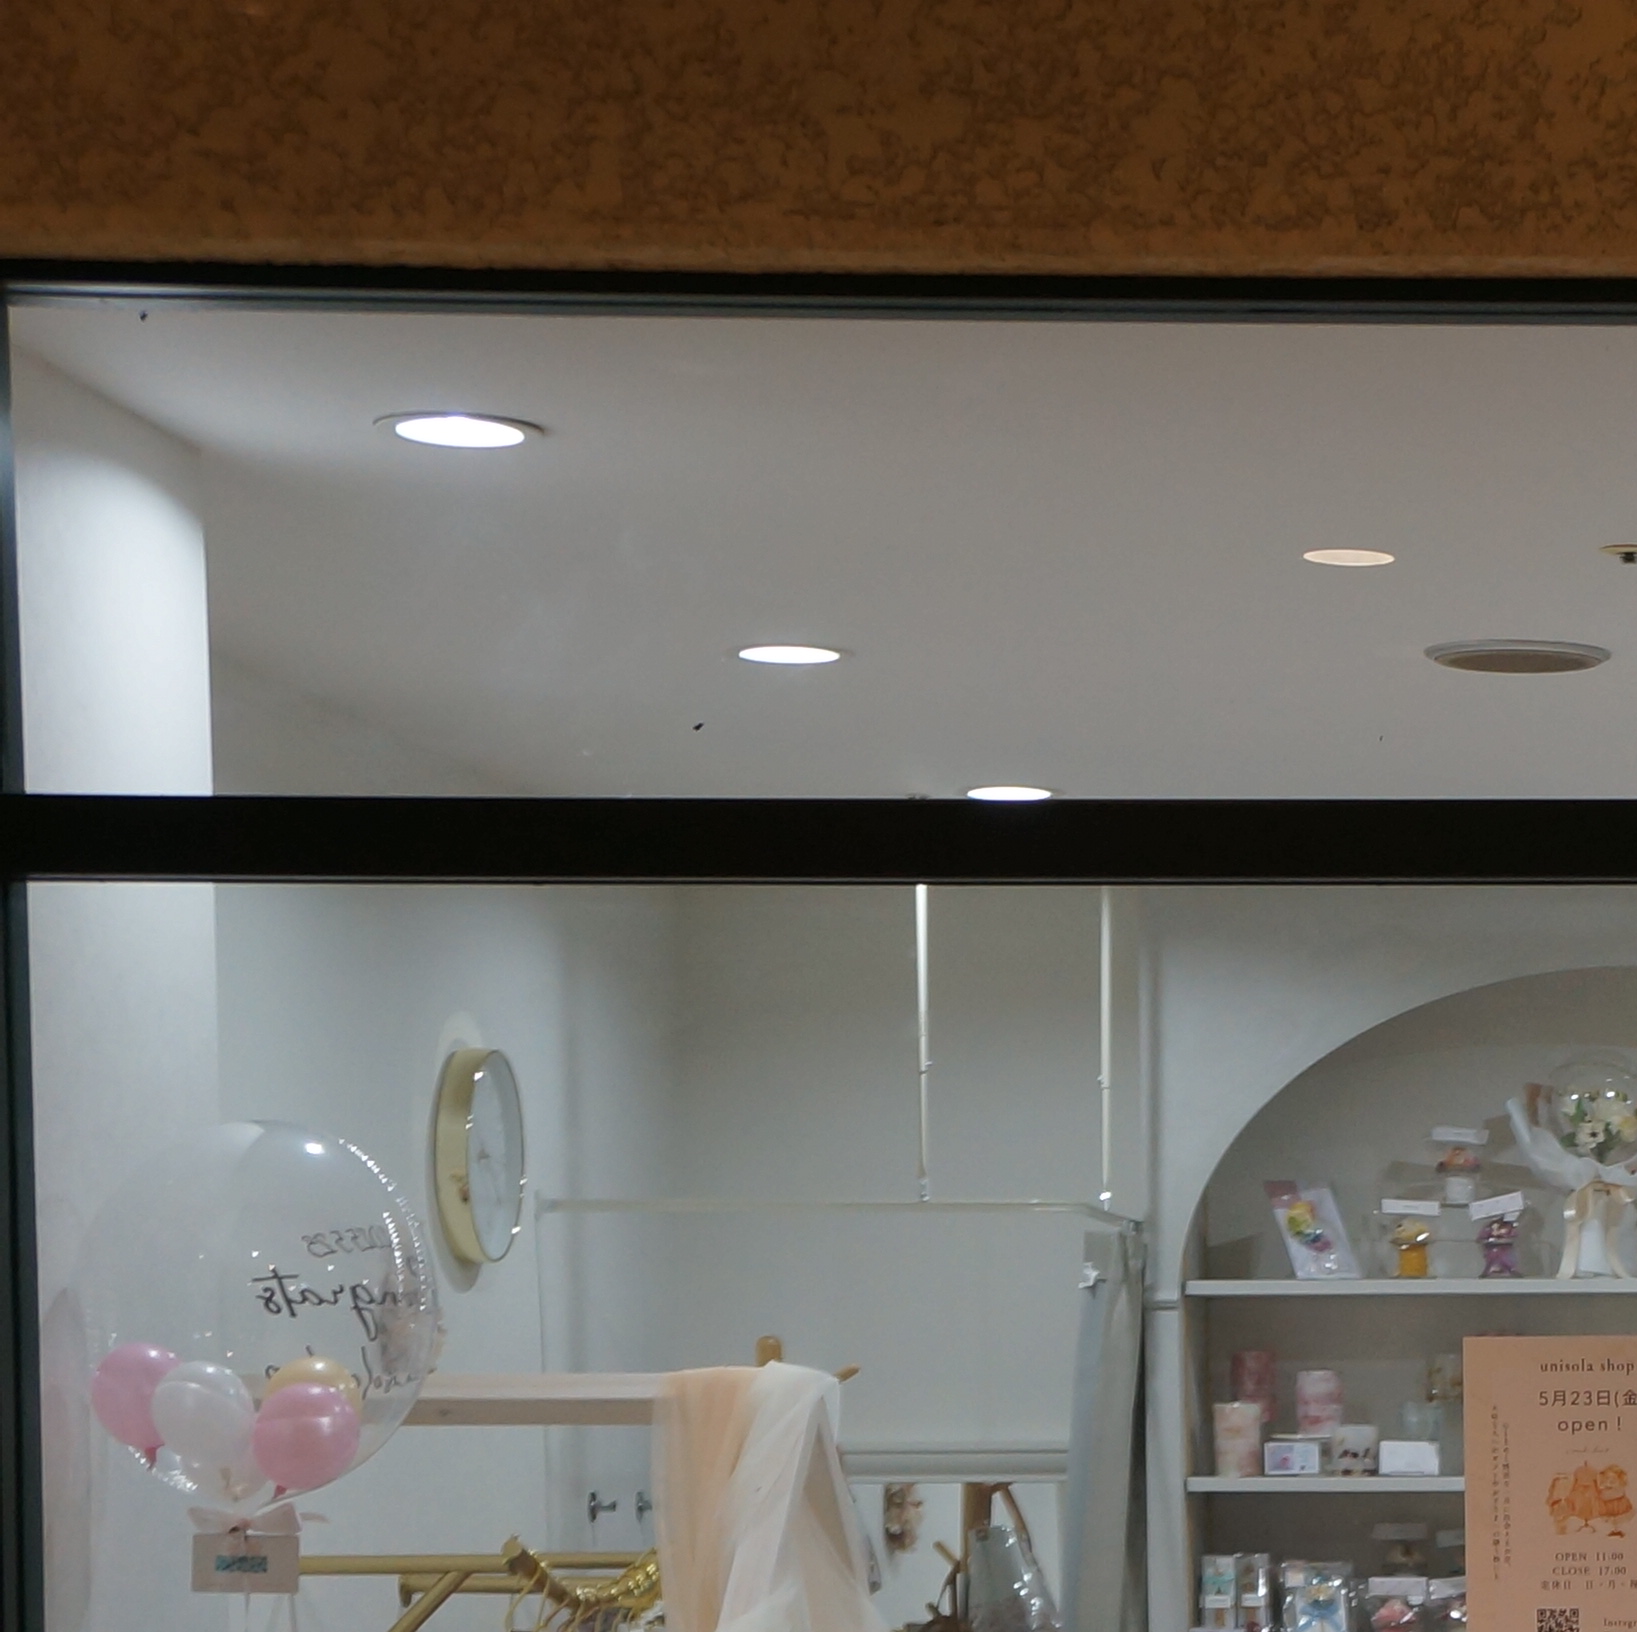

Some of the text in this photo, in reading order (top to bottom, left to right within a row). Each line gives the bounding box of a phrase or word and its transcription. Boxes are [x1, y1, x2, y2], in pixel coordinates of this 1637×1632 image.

[1539, 1358, 1635, 1377] unisola shop
[1554, 1551, 1625, 1562] OPEN 11:00
[1552, 1566, 1627, 1576] CLOSE 17:00
